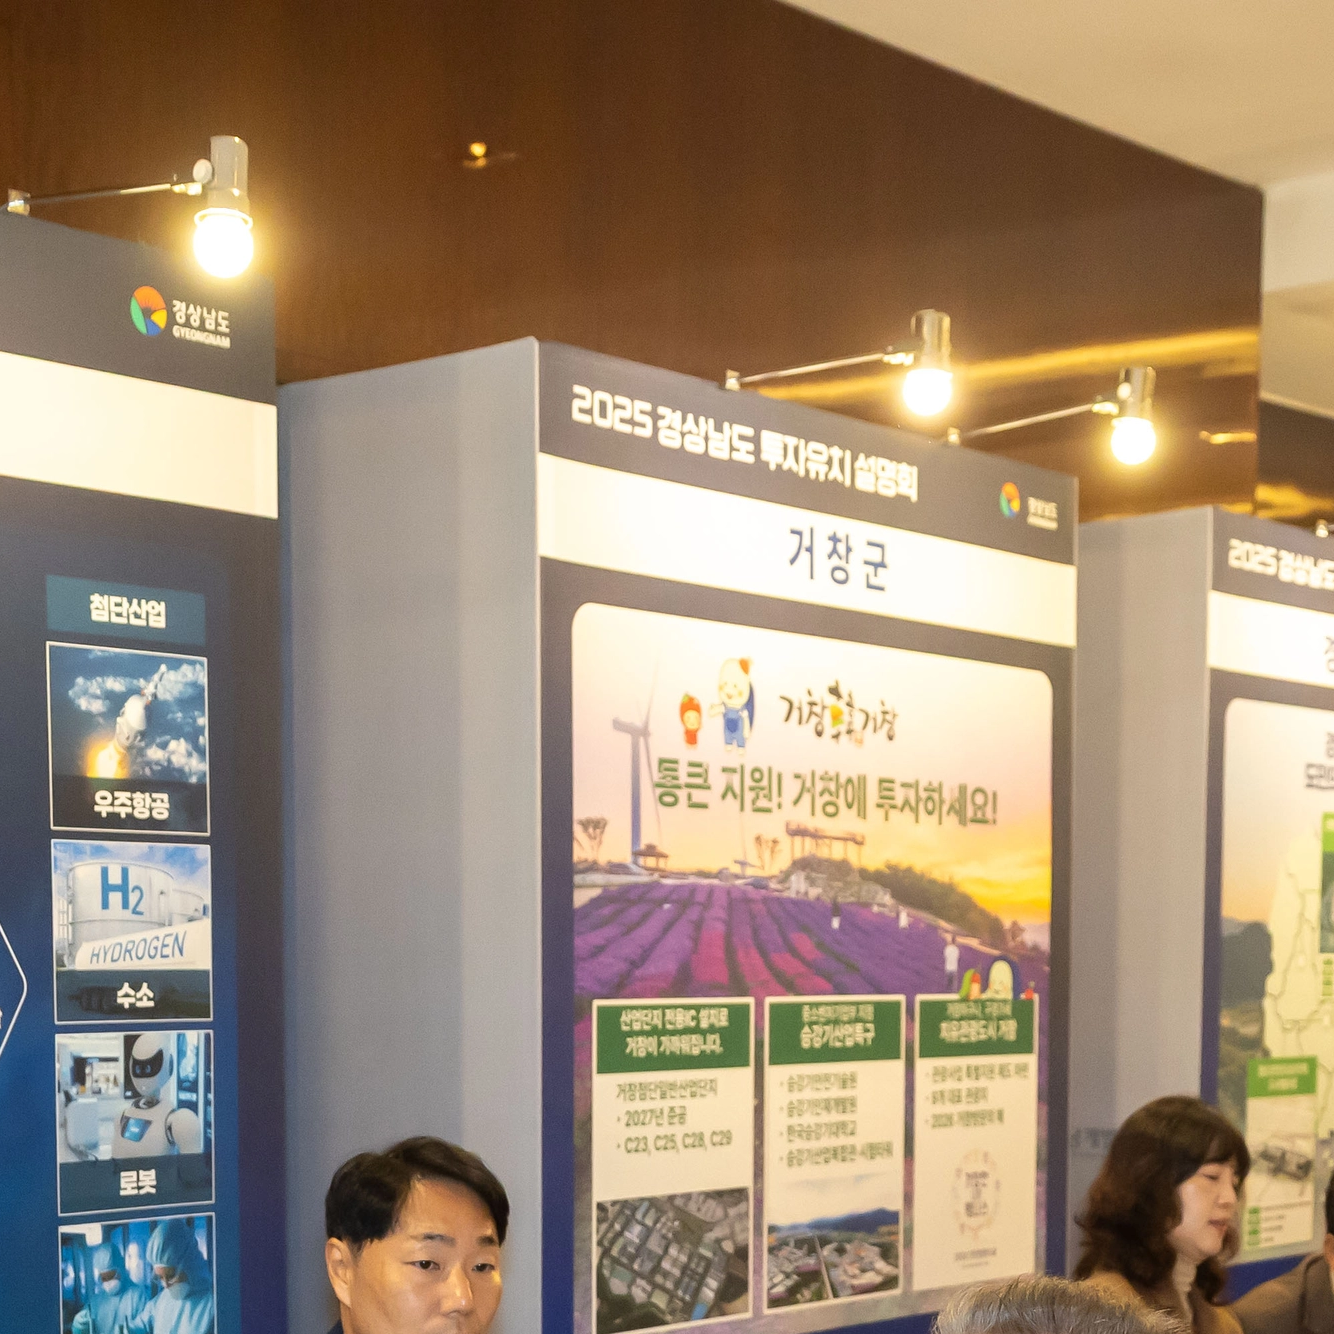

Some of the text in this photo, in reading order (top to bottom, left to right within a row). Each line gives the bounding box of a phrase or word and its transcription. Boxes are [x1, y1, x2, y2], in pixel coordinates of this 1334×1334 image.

[172, 300, 230, 334] 경상남도
[172, 325, 231, 349] GYEONGNAM
[571, 384, 919, 503] 2025 경상남도 투자유치 설명회
[789, 524, 888, 592] 거창군
[1228, 538, 1277, 575] 2025
[89, 592, 167, 629] 첨단산업
[93, 789, 170, 821] 우주항공
[654, 757, 711, 809] 통큰
[721, 763, 782, 813] 지원!
[876, 776, 999, 827] 투자하세요!
[89, 930, 188, 965] HYDROGEN
[115, 981, 155, 1010] 수소
[624, 1107, 665, 1128] 2027년
[119, 1168, 157, 1197] 로봇
